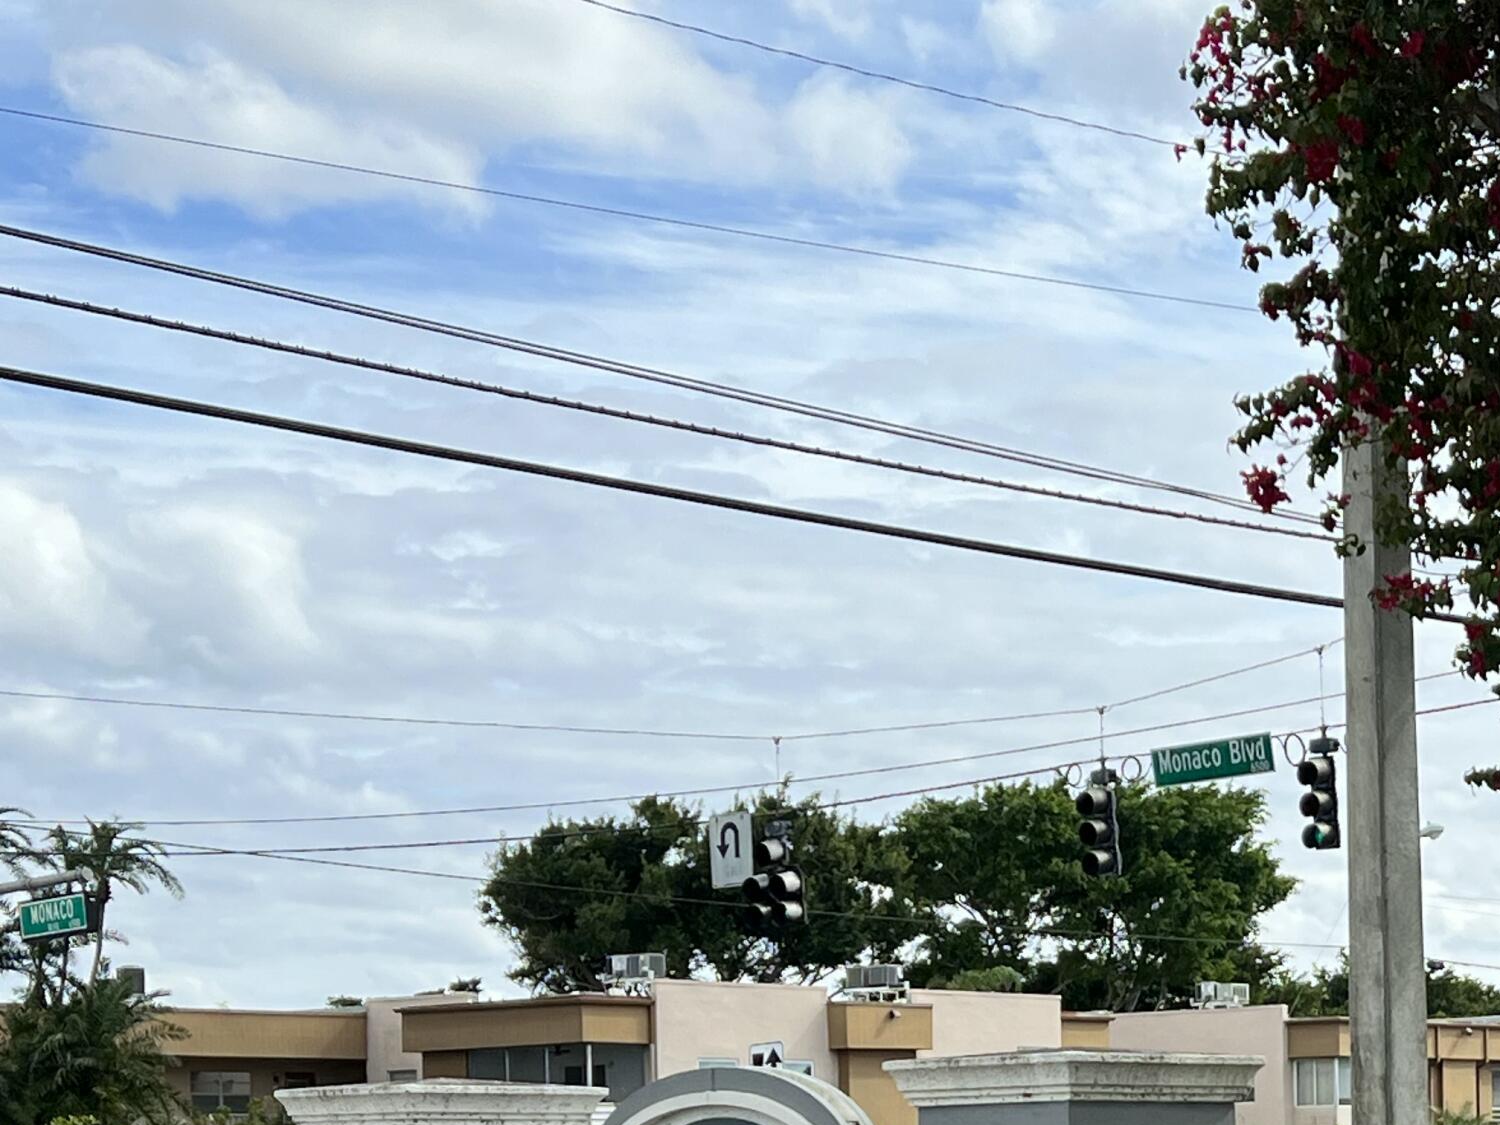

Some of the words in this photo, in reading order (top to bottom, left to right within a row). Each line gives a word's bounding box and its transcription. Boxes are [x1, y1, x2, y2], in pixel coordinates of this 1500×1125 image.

[1158, 748, 1222, 774] Monaco
[1228, 737, 1266, 764] Blvd
[30, 900, 74, 925] MONACO
